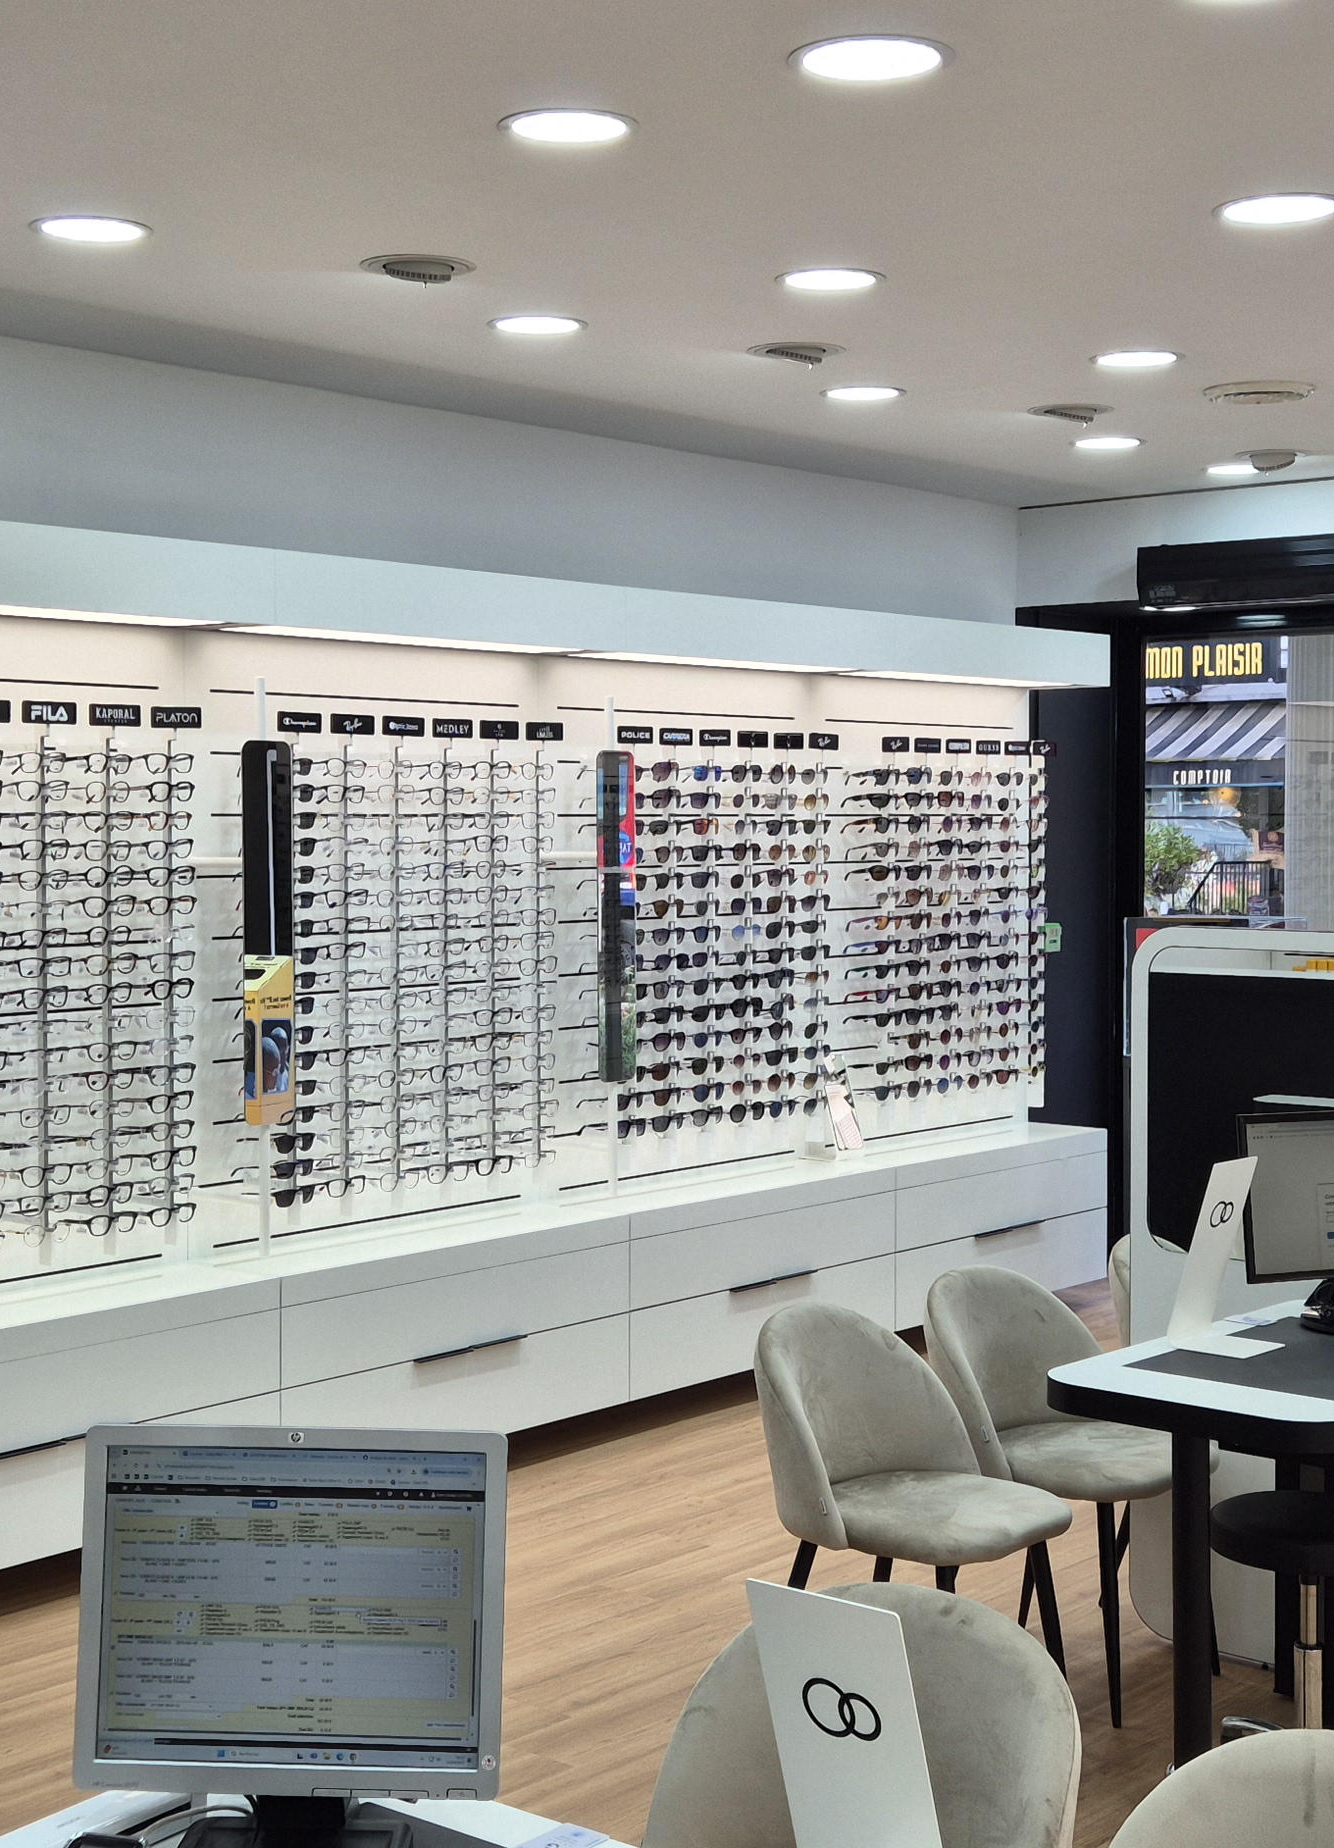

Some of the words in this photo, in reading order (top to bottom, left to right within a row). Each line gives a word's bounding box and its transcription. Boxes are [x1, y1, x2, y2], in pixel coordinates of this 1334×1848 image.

[1146, 646, 1183, 679] MON
[1192, 642, 1263, 678] PLAISIR
[30, 705, 69, 722] FILA
[95, 707, 136, 719] KAPORAL
[156, 712, 198, 724] PLATON
[436, 723, 470, 735] MEDLEY
[621, 731, 651, 740] POLICE
[1173, 769, 1232, 785] COMPTOIR
